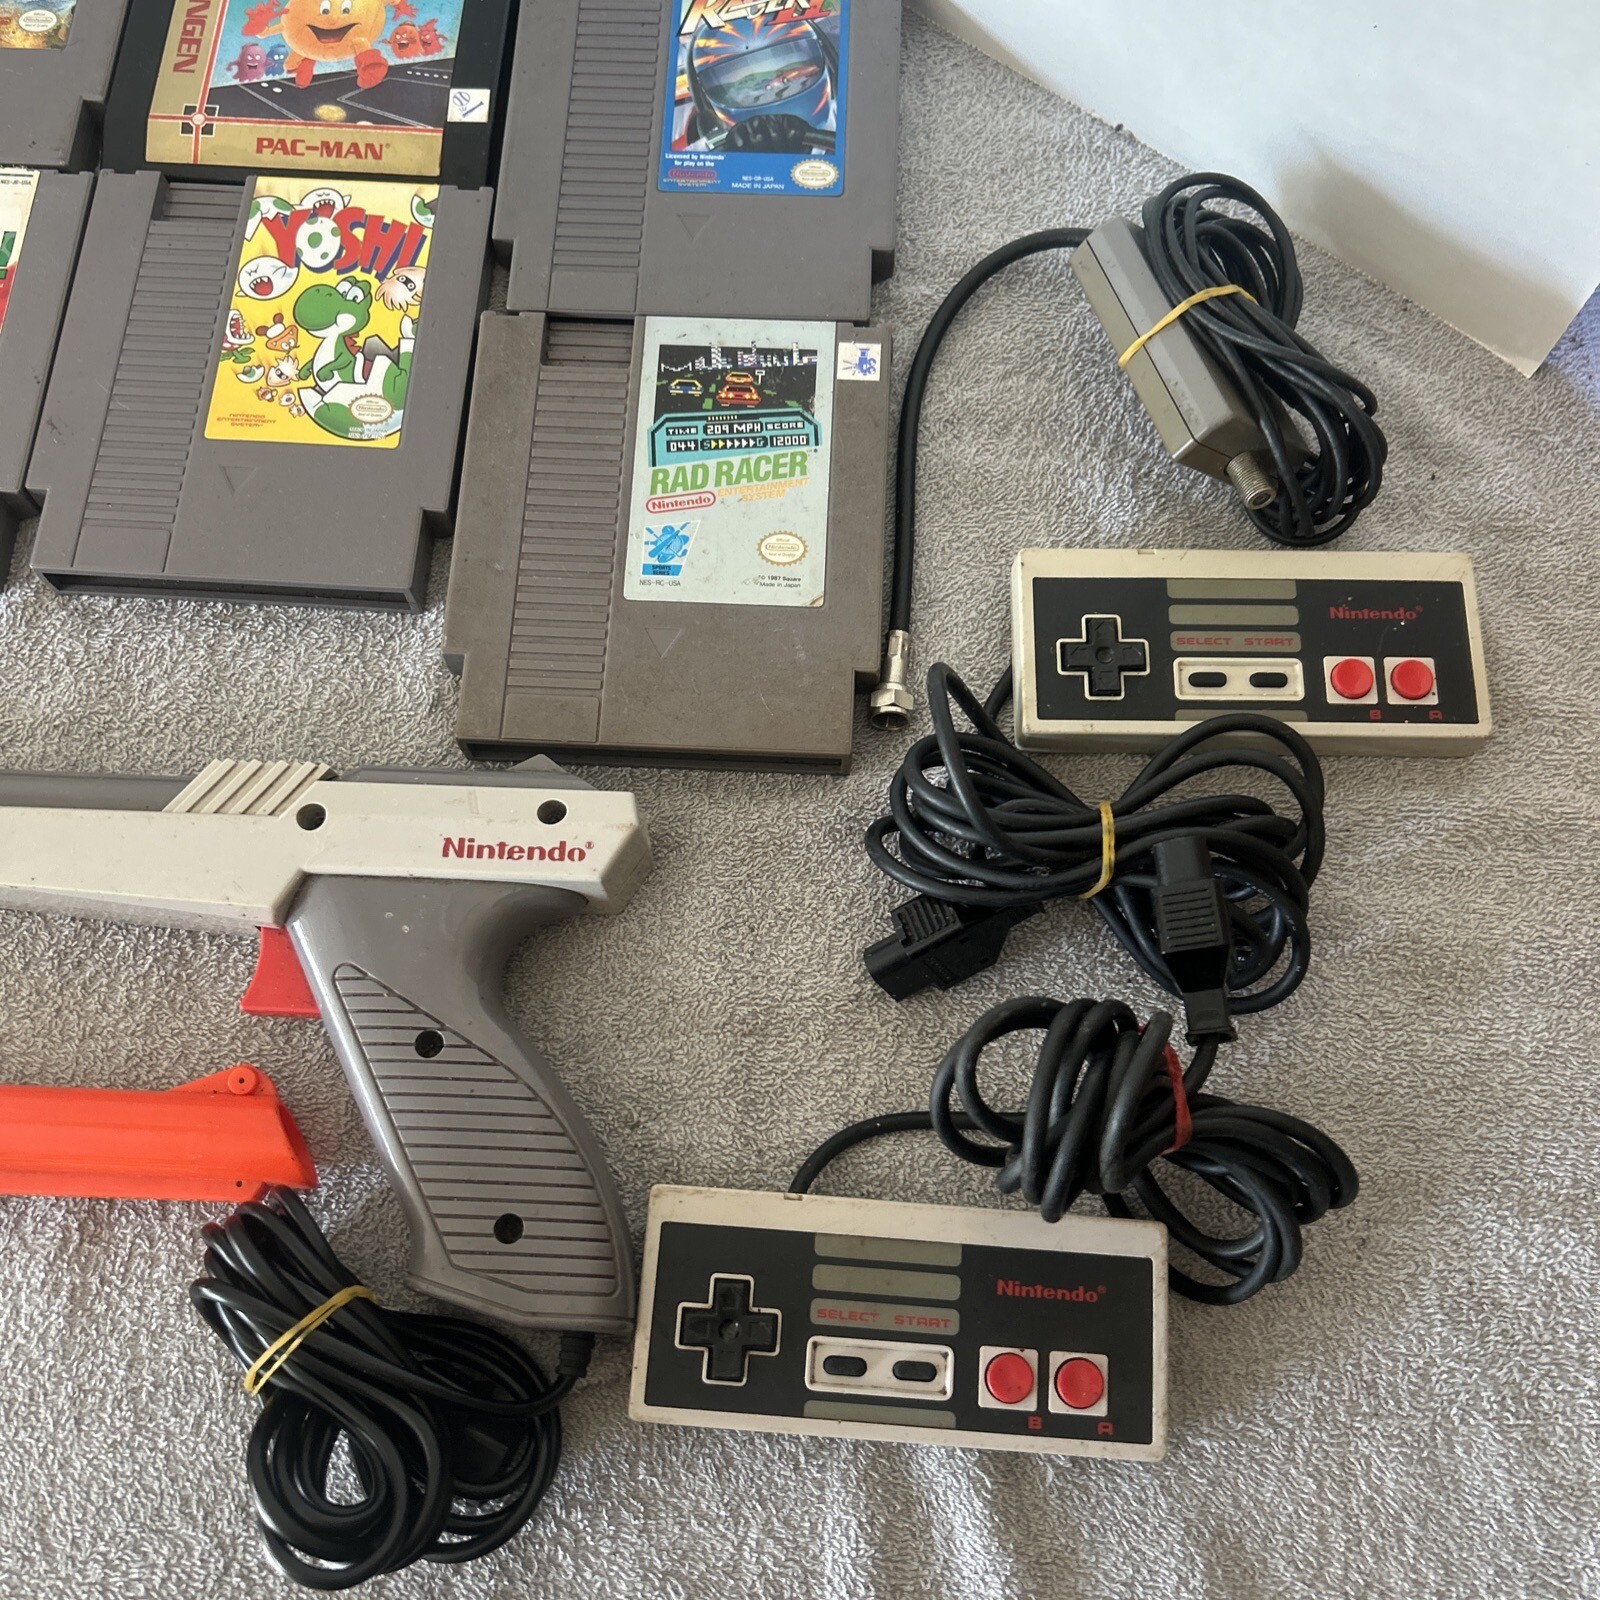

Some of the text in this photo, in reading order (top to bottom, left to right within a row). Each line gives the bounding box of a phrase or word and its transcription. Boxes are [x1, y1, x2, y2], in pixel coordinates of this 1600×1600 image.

[256, 137, 383, 160] PAC-MAN
[706, 423, 761, 435] 209 MPH
[767, 421, 804, 429] SCORE
[670, 440, 695, 451] 044
[773, 435, 806, 446] 12000
[650, 450, 809, 496] RAD RACER
[717, 477, 810, 498] ENTERTAINMENT
[651, 495, 711, 510] Nintendo
[741, 489, 787, 503] SYSTEM
[1176, 637, 1294, 646] SELECT START
[1369, 709, 1382, 720] B
[1429, 710, 1443, 720] A
[817, 1308, 952, 1329] SELECT START
[1028, 1416, 1043, 1430] B
[1098, 1421, 1114, 1435] A
